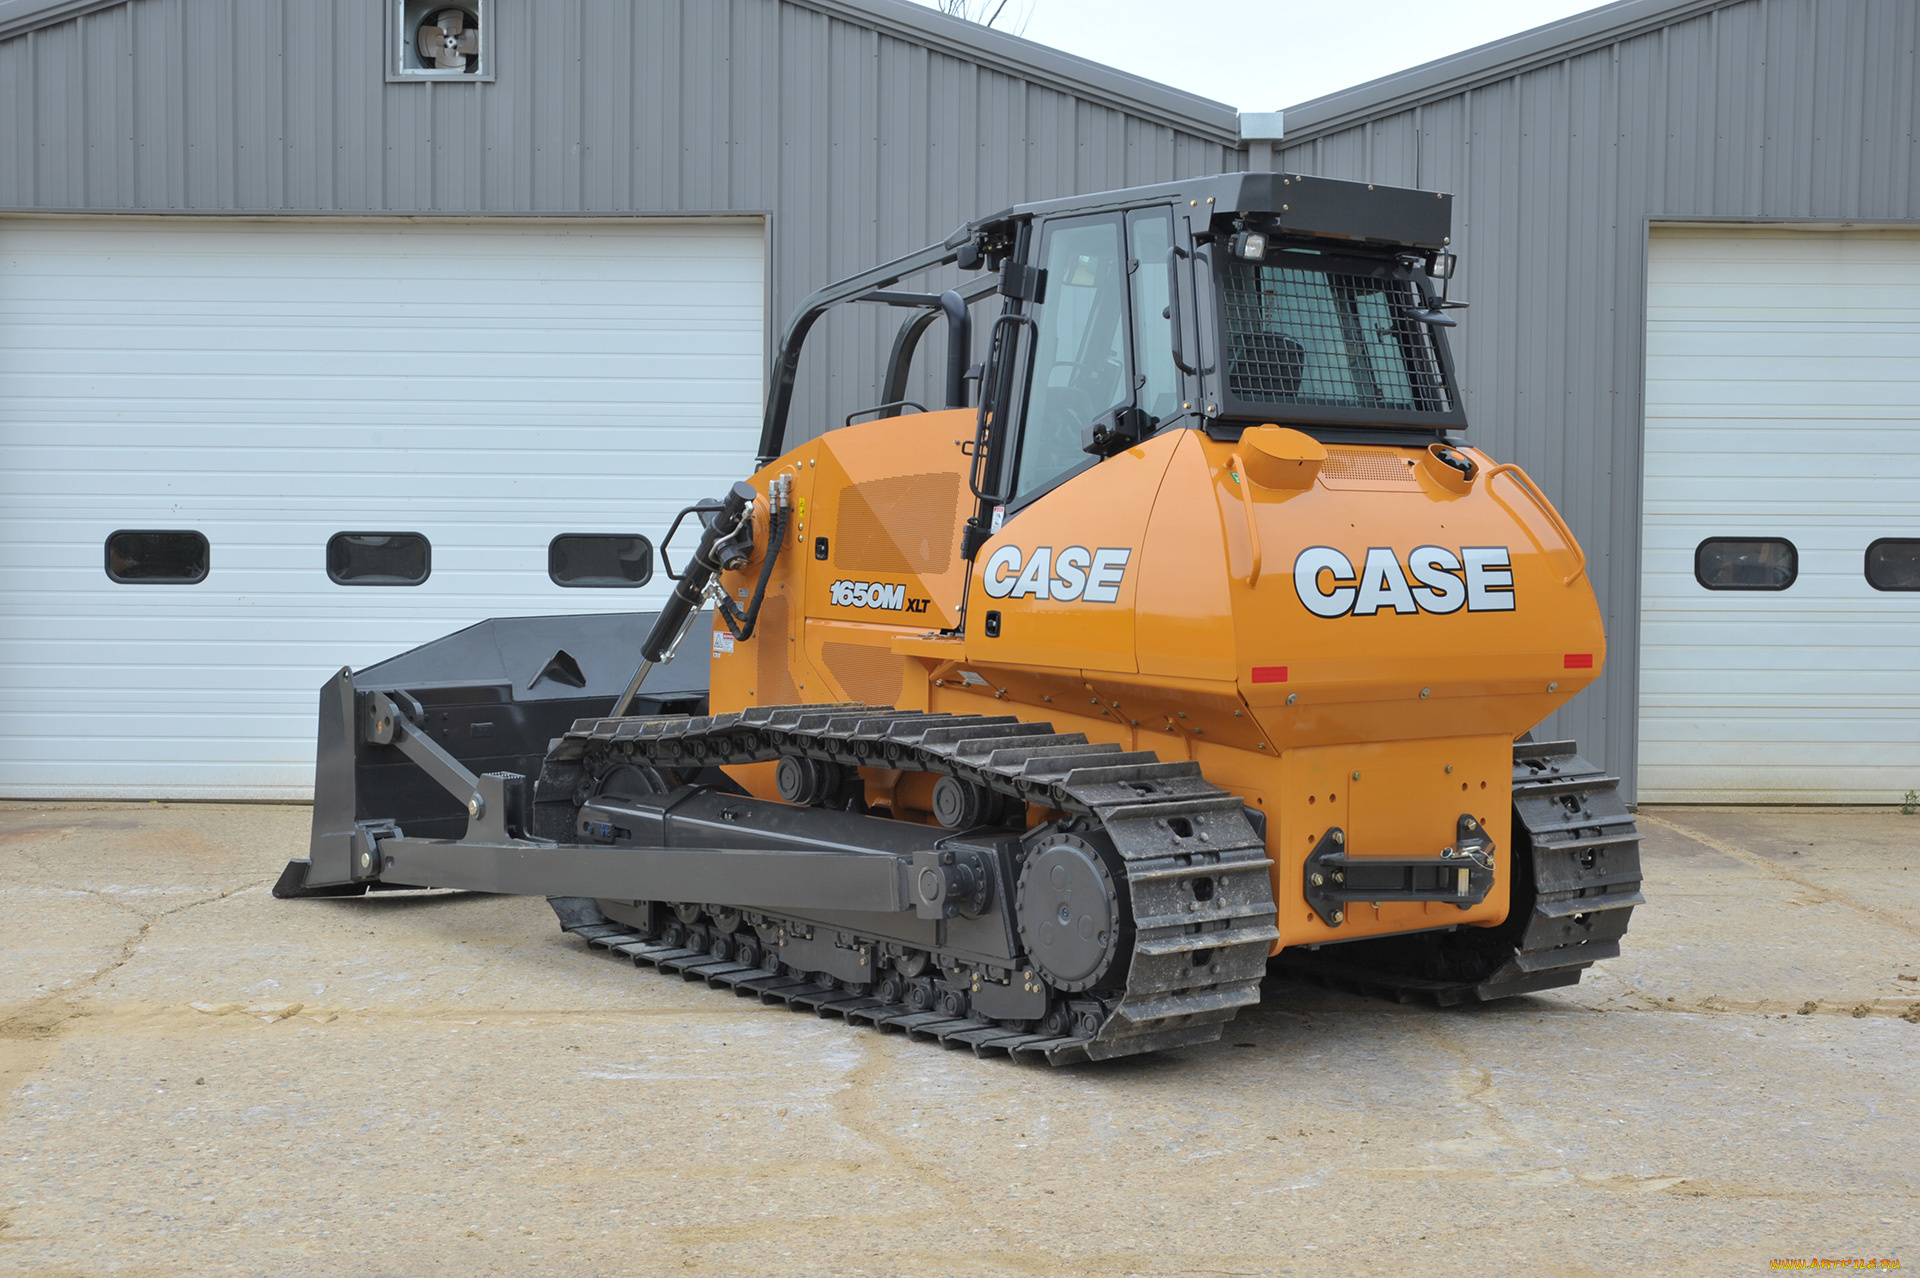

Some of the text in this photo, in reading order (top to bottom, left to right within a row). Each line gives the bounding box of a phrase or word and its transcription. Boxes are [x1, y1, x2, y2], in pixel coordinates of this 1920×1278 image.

[830, 579, 931, 613] 1650M XLT
[983, 544, 1132, 604] CASE
[1293, 544, 1516, 619] CASE
